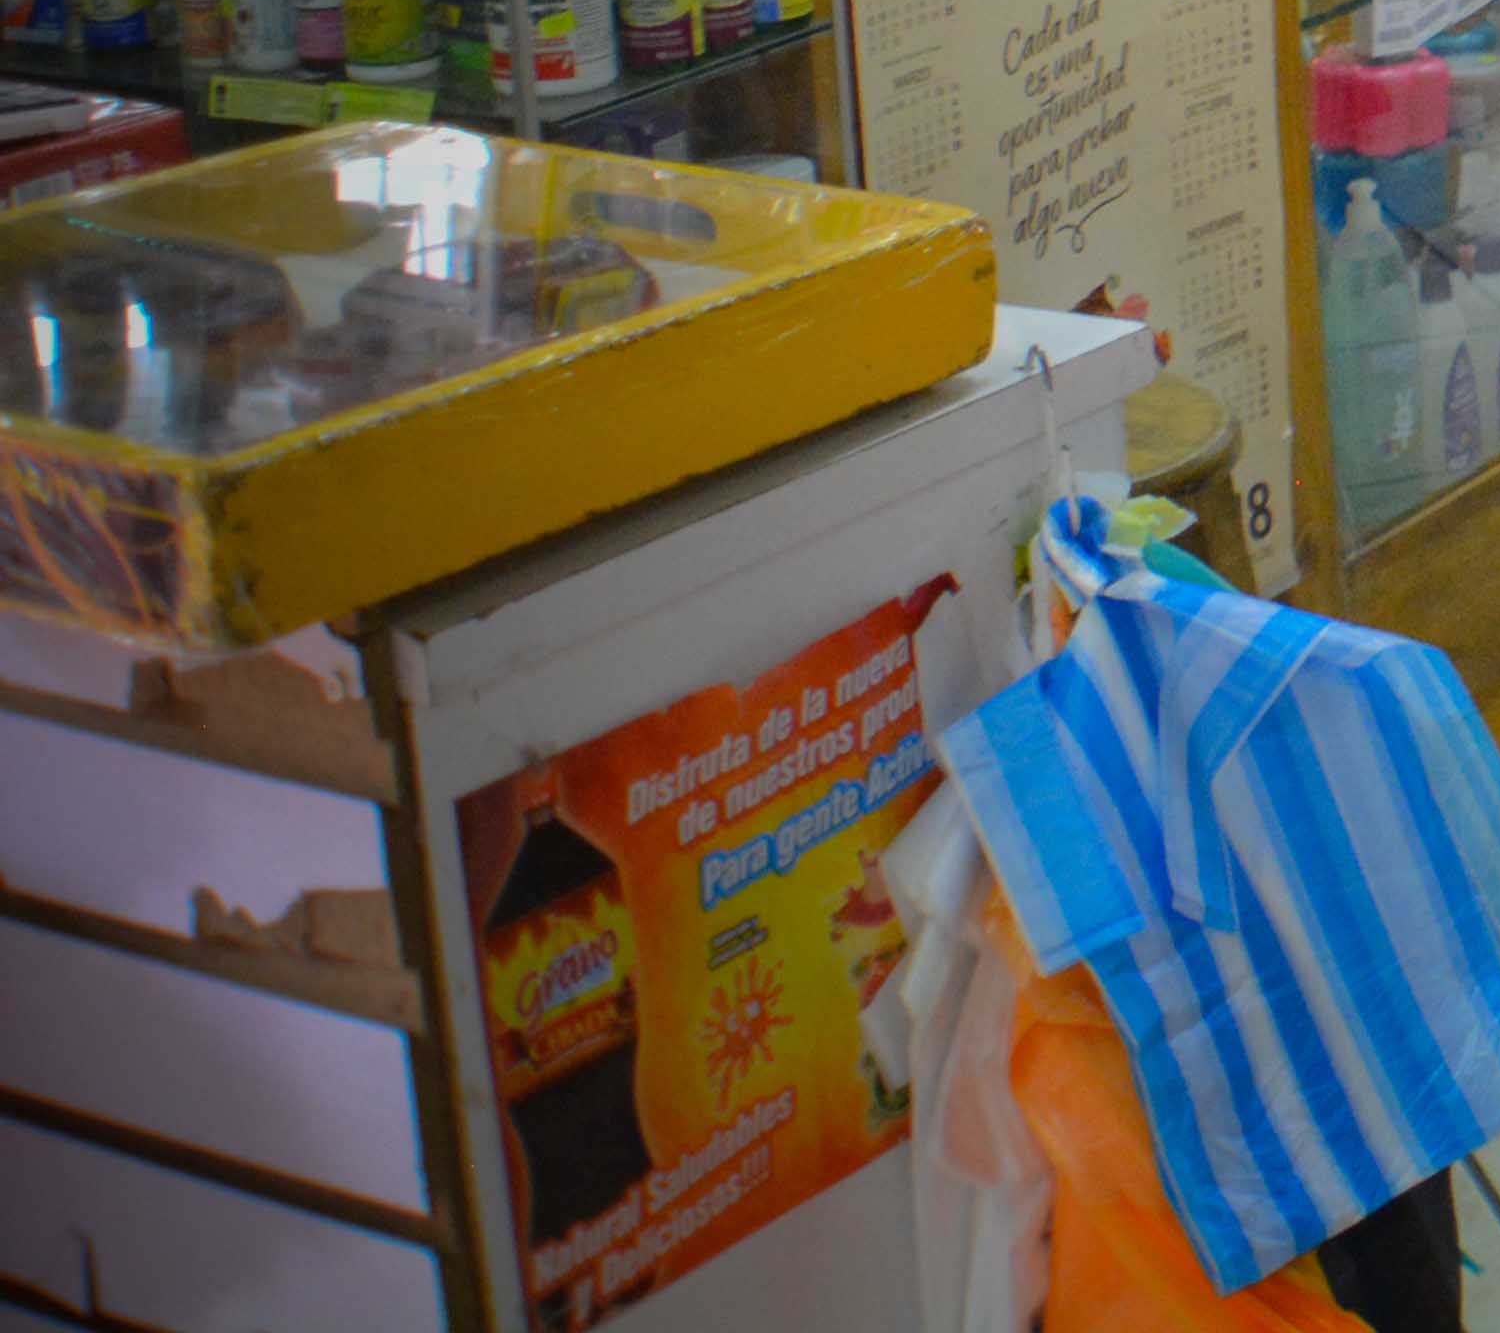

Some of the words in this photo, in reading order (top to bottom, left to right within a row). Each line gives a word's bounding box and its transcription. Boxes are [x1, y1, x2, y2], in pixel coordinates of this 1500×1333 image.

[1002, 5, 1064, 76] Cada
[1024, 55, 1050, 96] es
[1052, 36, 1095, 81] una
[999, 42, 1130, 156] oportunidad
[1008, 150, 1064, 214] para
[1064, 102, 1135, 185] probar
[1012, 193, 1062, 244] algo
[1066, 155, 1129, 213] nuevo
[627, 734, 751, 825] Disfruta
[757, 709, 792, 748] de
[801, 685, 829, 725] la
[835, 638, 911, 709] nueva
[677, 810, 717, 845] de
[726, 731, 854, 819] nuestros
[700, 837, 769, 903] Para
[776, 791, 861, 875] gente
